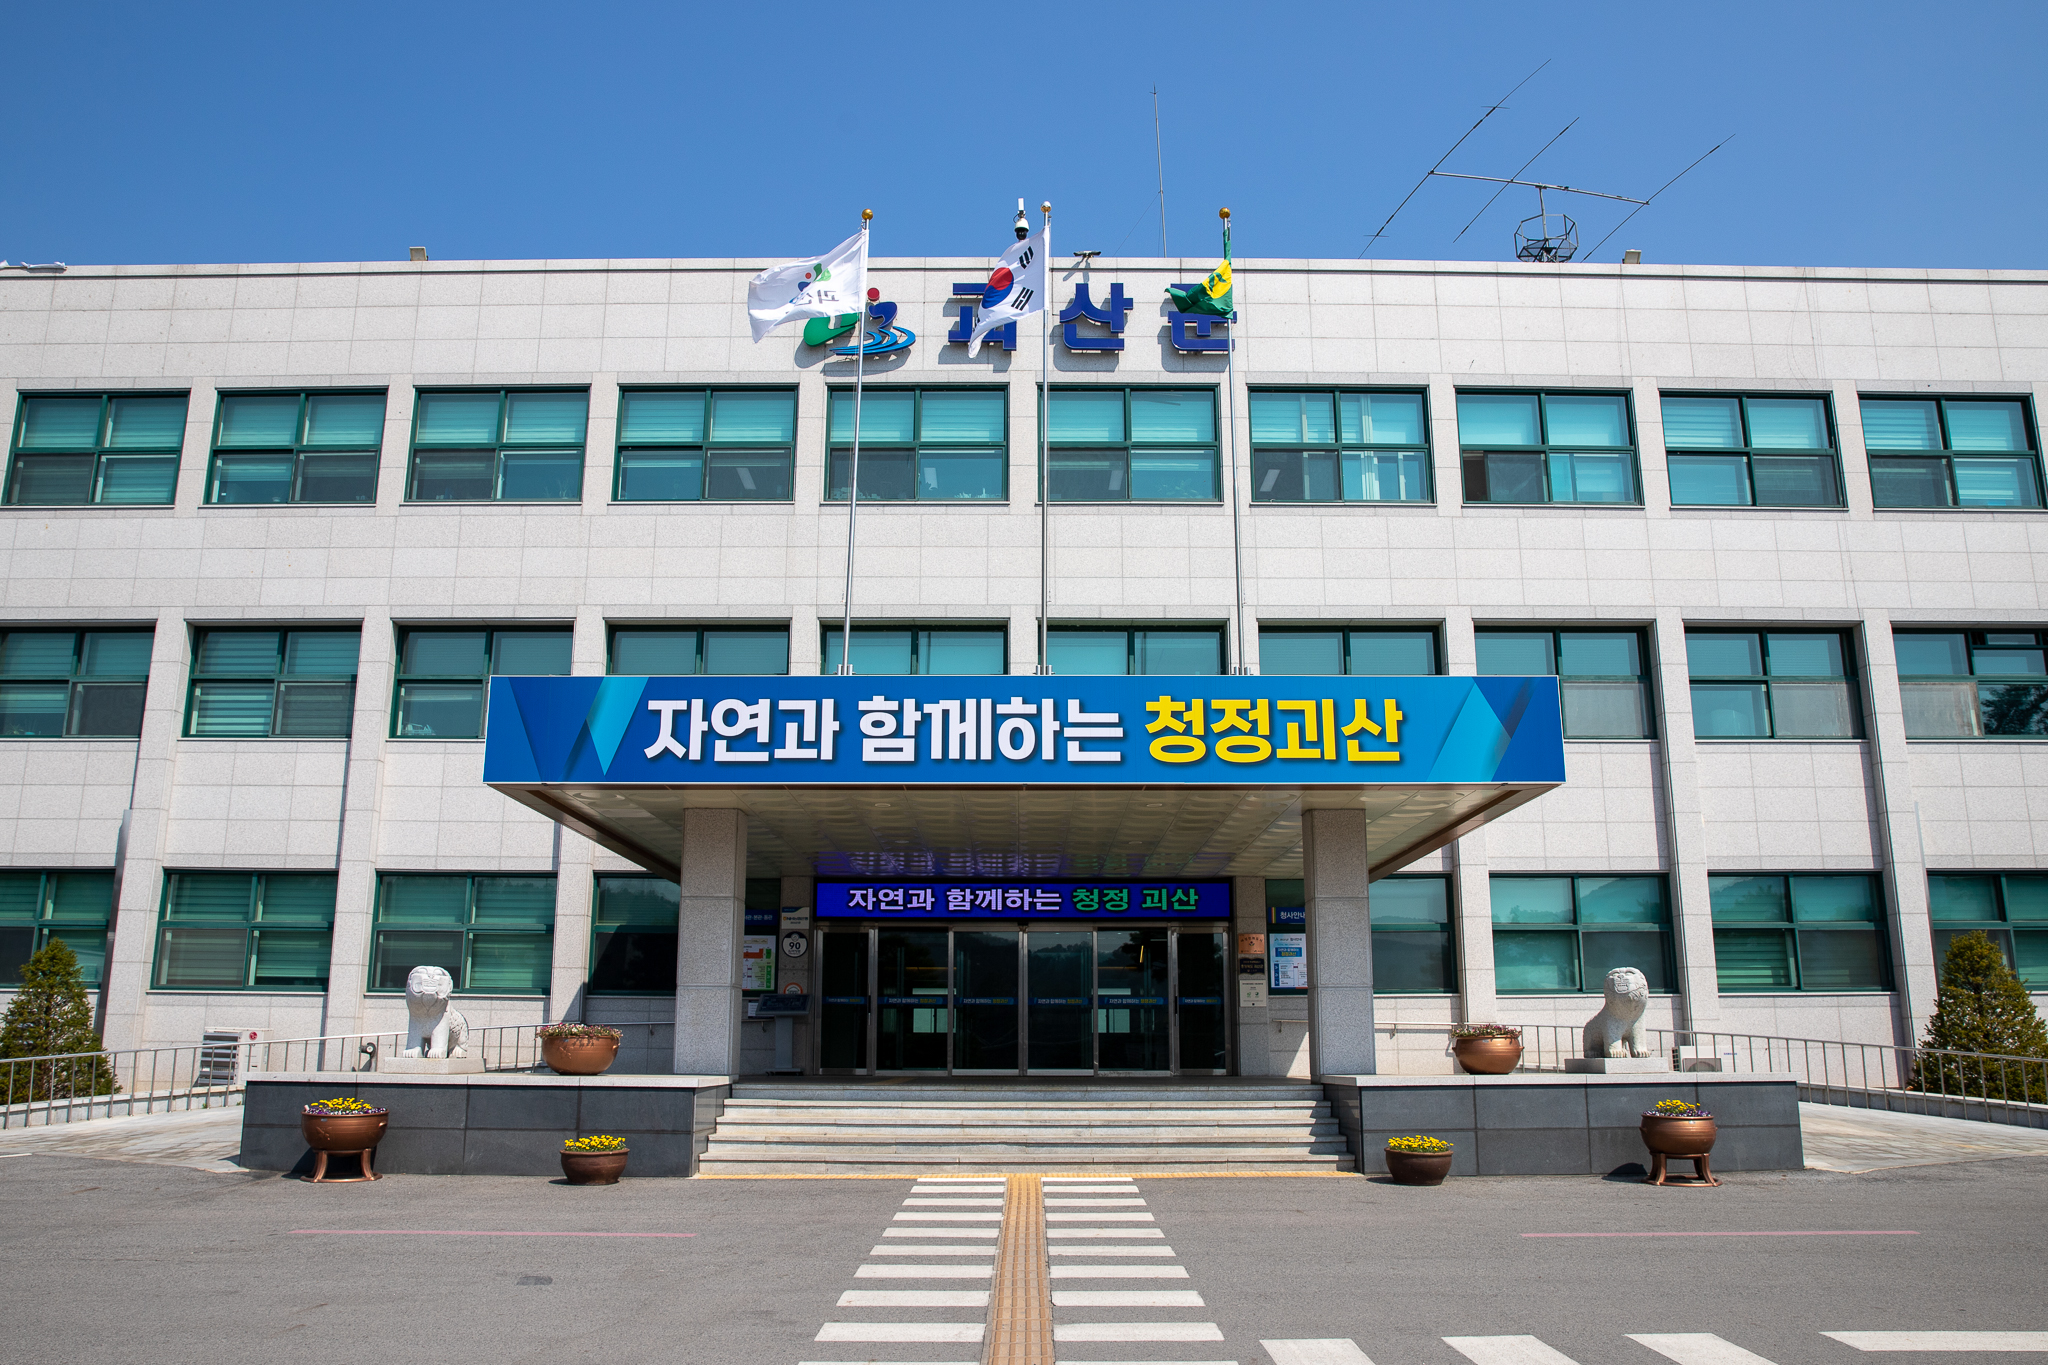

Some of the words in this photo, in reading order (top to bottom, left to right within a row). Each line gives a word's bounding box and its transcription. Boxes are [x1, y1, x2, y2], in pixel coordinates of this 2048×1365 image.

[644, 698, 839, 762] 자연과
[859, 696, 1123, 763] 함께하는
[1145, 695, 1403, 764] 청정괴산
[848, 888, 935, 911] 자연과
[946, 887, 1062, 911] 함께하는
[1072, 887, 1130, 911] 청정
[1141, 887, 1199, 911] 괴산
[789, 942, 801, 950] 90
